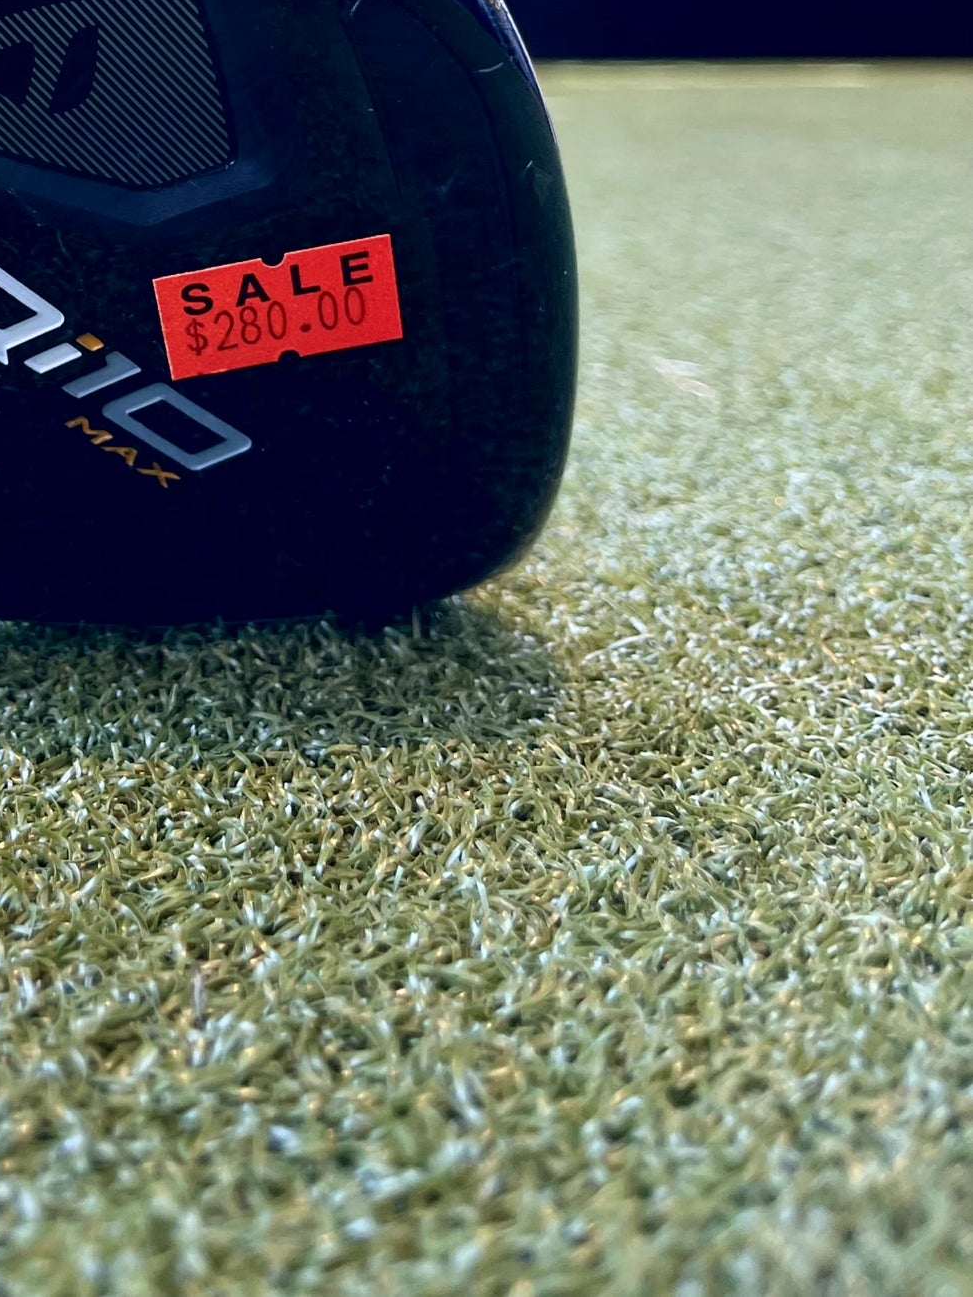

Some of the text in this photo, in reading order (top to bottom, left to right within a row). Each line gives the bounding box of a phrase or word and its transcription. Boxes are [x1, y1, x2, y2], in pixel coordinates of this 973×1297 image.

[181, 251, 374, 316] SALE
[185, 287, 366, 357] $280.00
[64, 416, 181, 488] MAX
